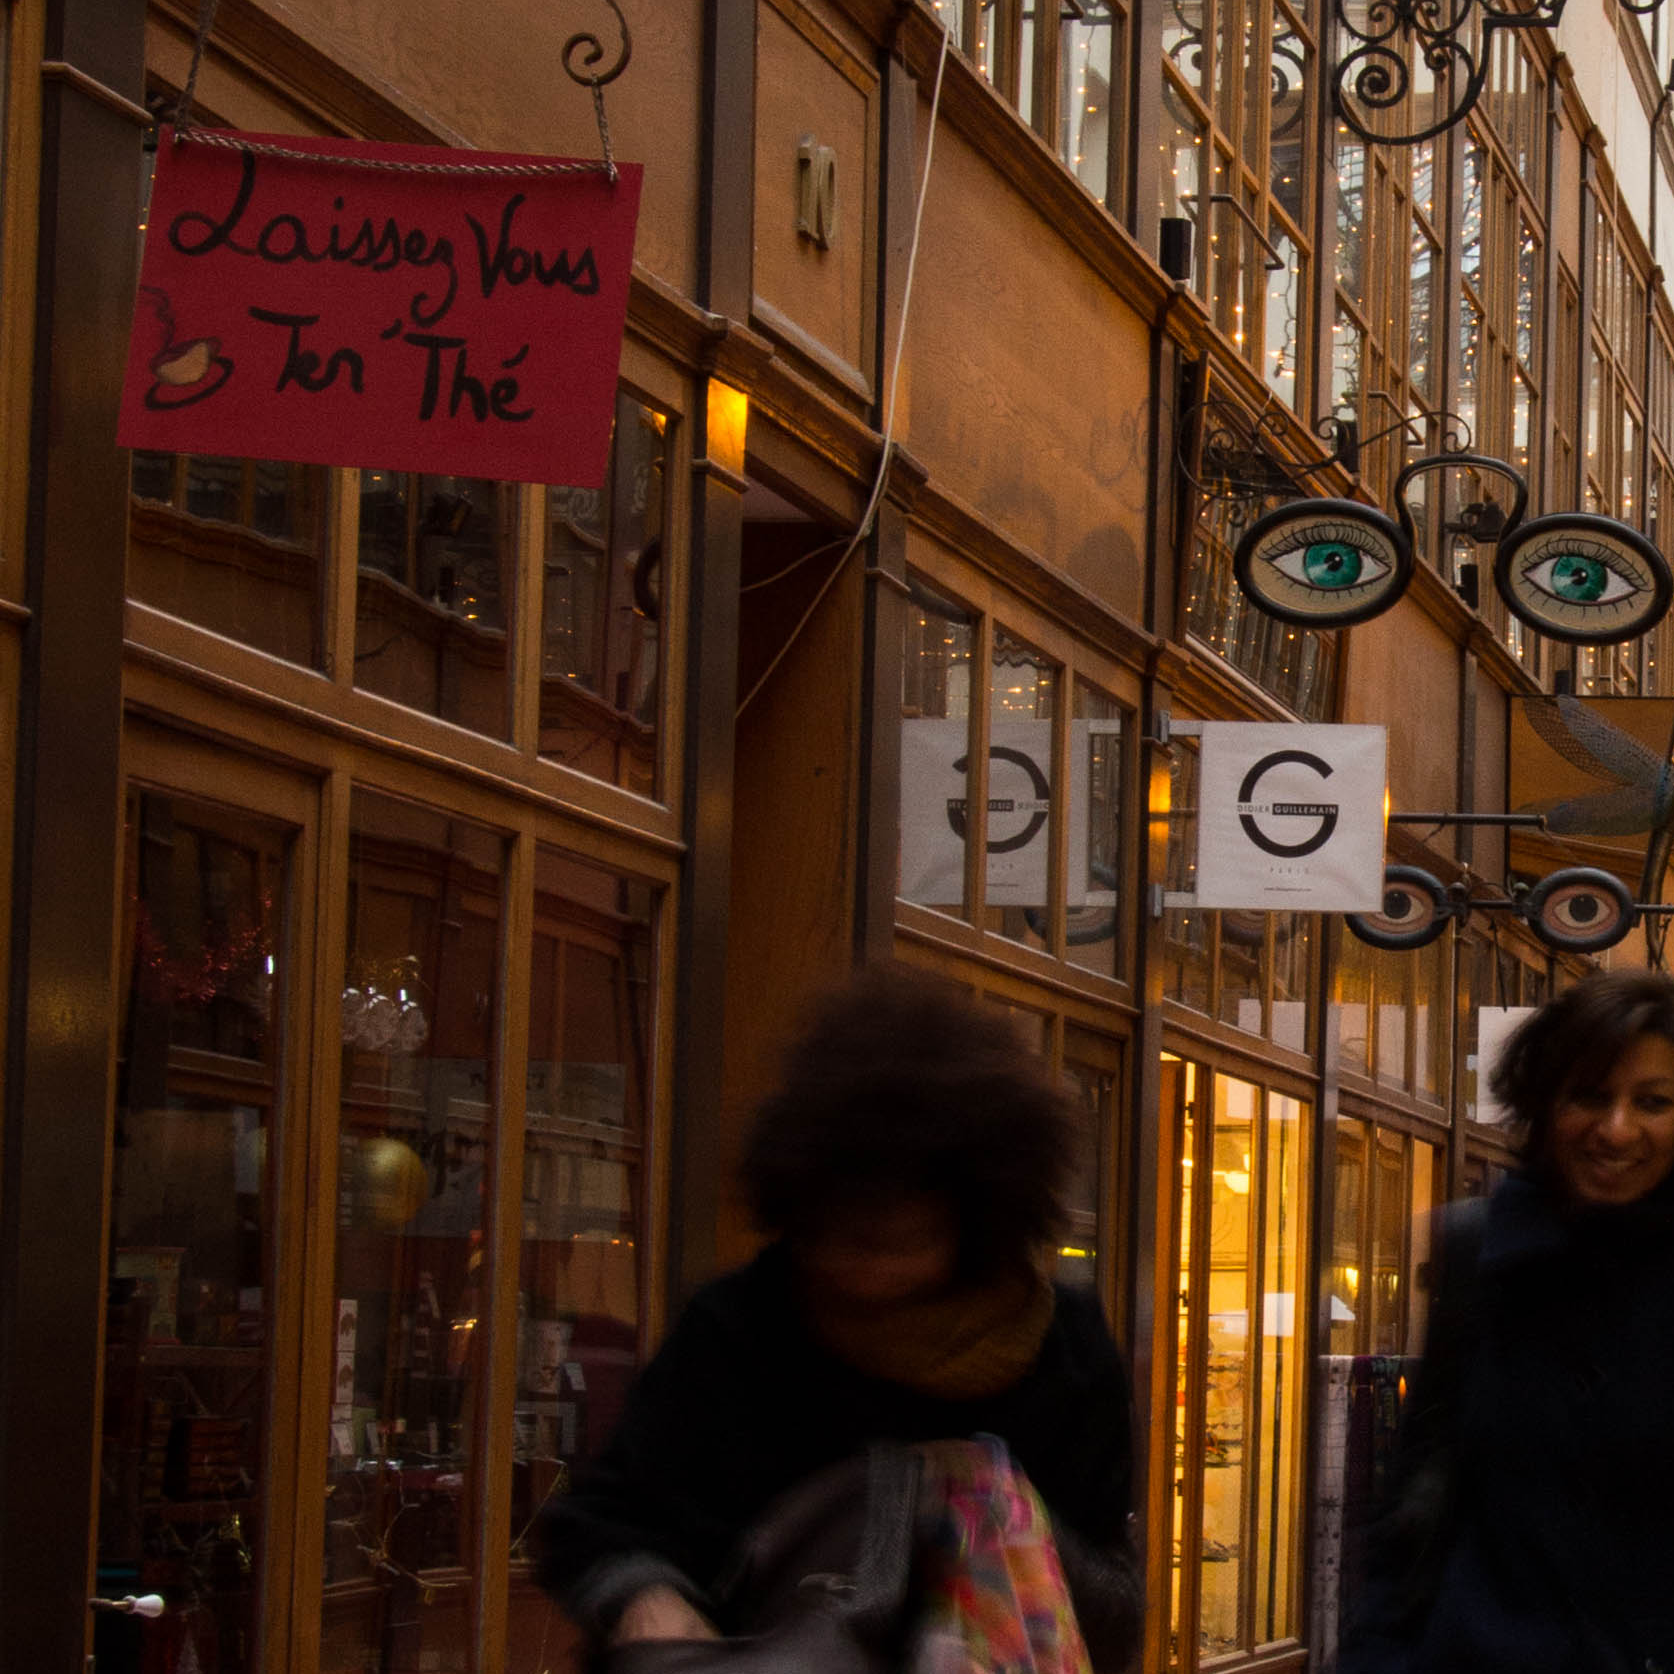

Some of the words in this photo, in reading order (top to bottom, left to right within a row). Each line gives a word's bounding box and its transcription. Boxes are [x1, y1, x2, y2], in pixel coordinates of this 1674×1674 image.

[168, 150, 459, 327] Laissez
[465, 194, 599, 299] Vous
[1274, 805, 1337, 815] GUILLEMAIN
